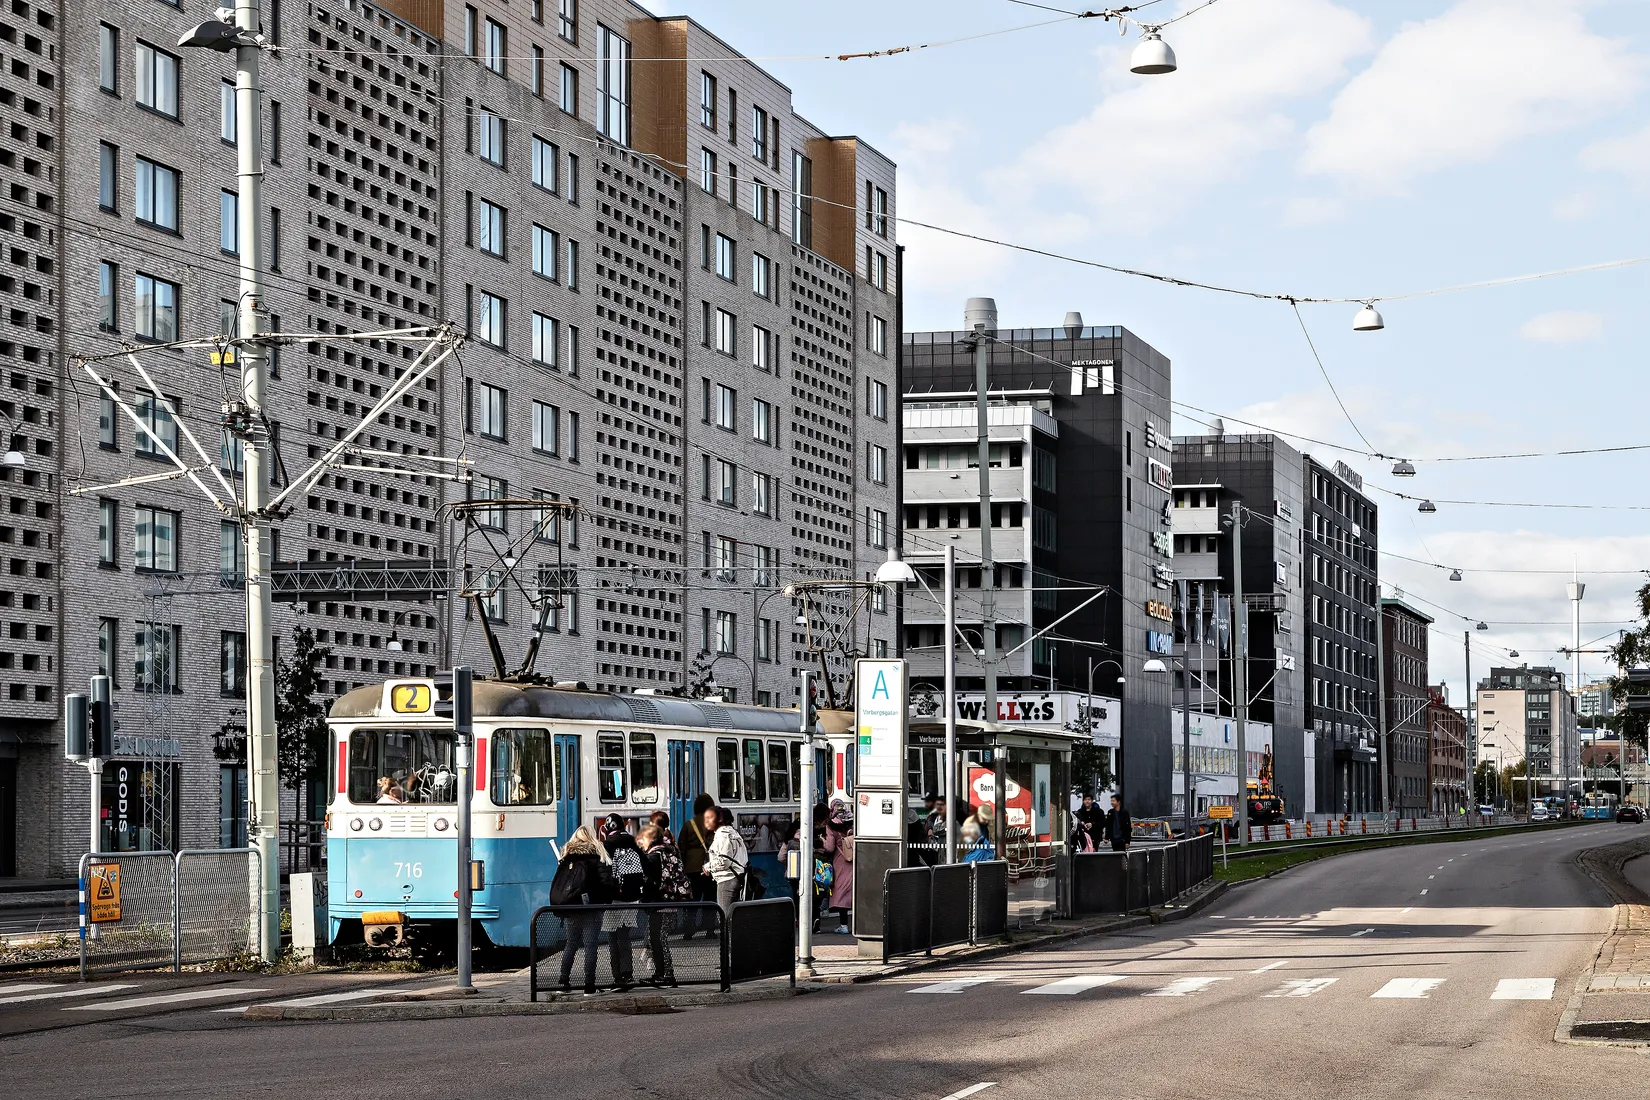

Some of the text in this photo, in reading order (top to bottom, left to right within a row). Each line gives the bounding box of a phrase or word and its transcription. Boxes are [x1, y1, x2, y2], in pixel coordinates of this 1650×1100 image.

[871, 669, 890, 700] A
[405, 686, 418, 709] 2
[862, 708, 899, 717] Varbergsgatan
[866, 737, 871, 745] 4
[980, 783, 994, 792] Bara
[119, 766, 128, 833] GODIS
[1005, 826, 1031, 839] ifflar
[393, 861, 423, 878] 716
